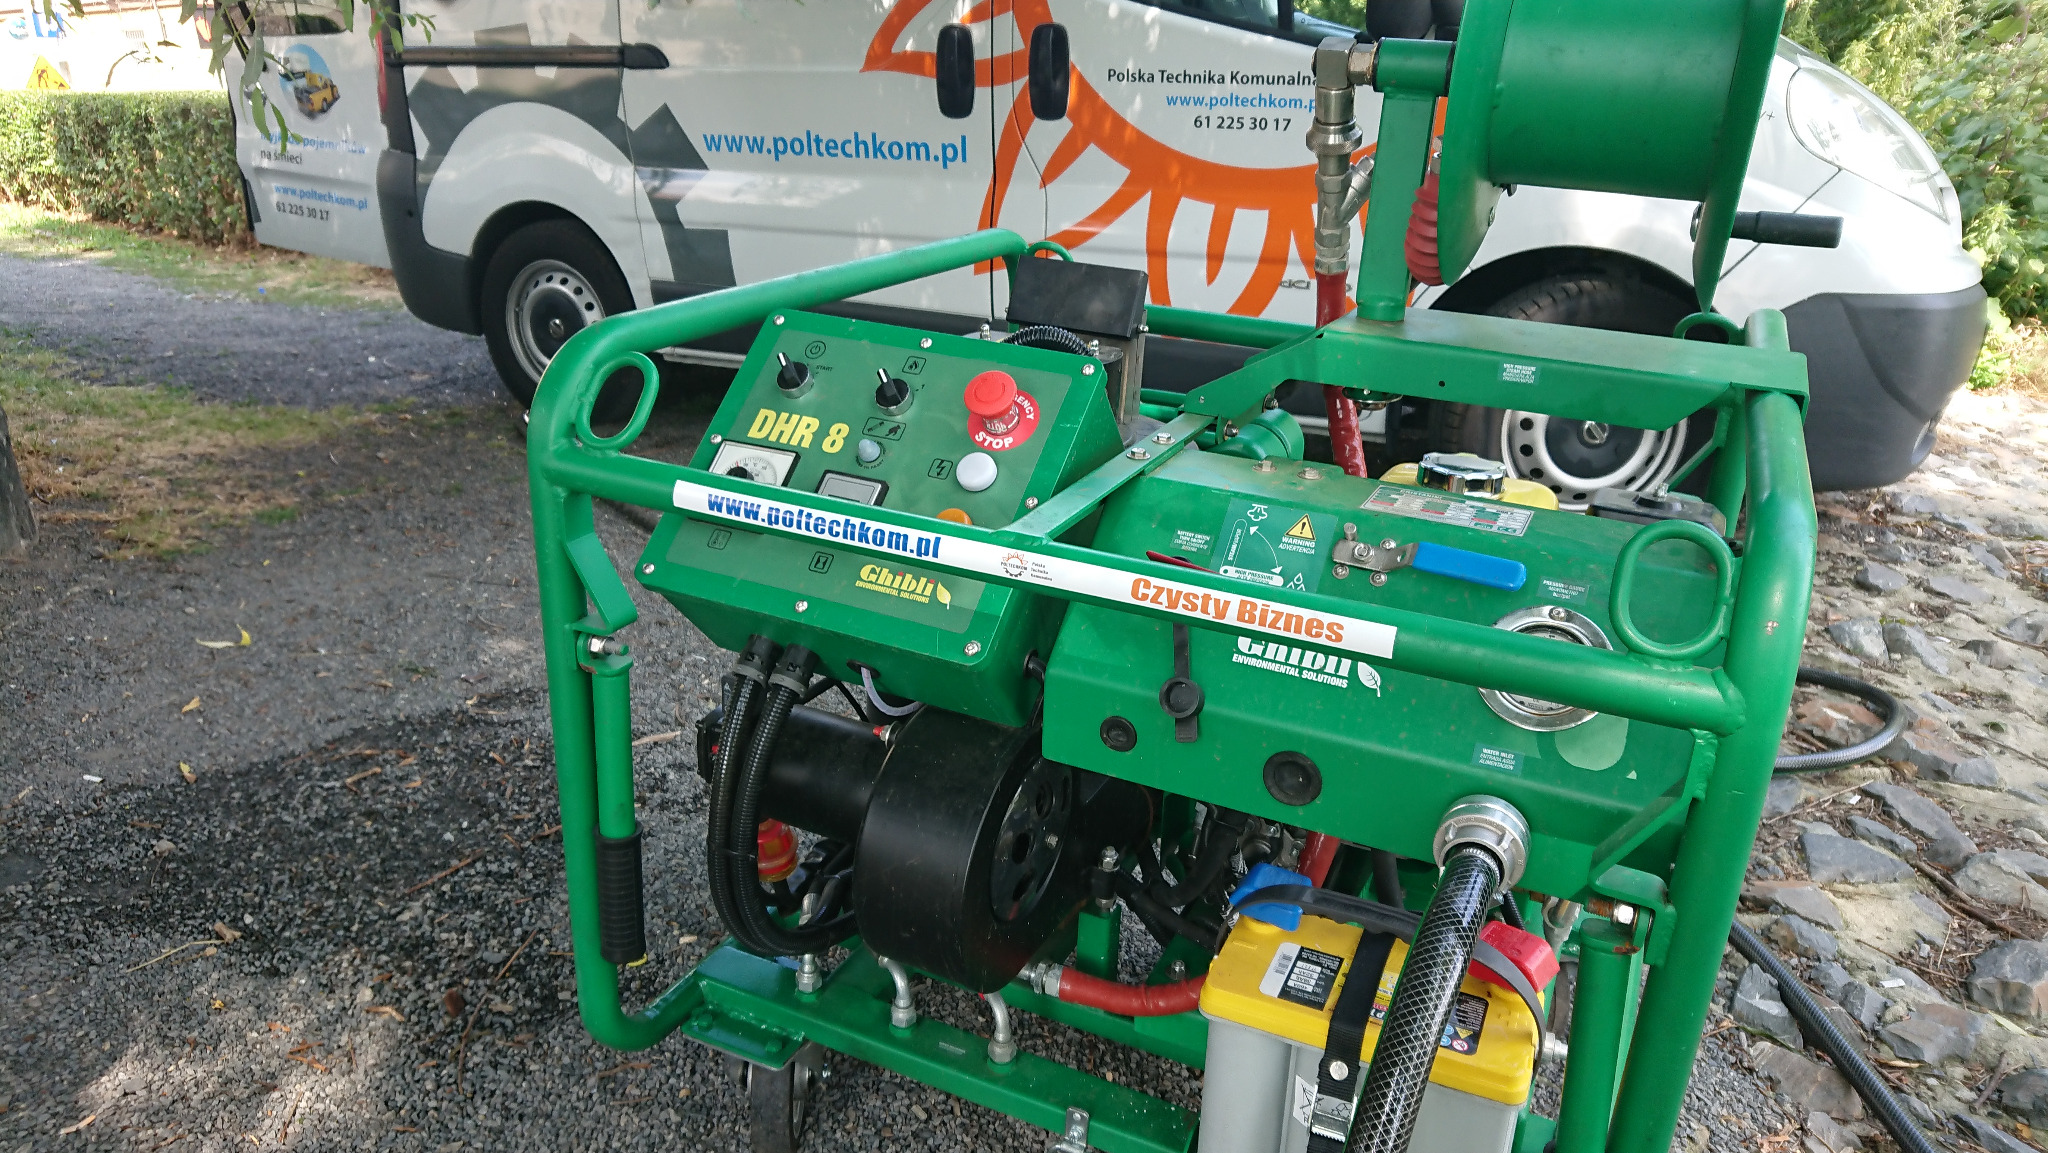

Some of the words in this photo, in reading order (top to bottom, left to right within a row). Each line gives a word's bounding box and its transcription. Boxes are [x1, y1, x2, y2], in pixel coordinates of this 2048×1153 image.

[1107, 68, 1155, 83] Polska
[1158, 69, 1226, 84] Technika
[1166, 93, 1317, 112] www.poltechkom.p
[1193, 116, 1211, 129] 61
[1216, 117, 1245, 129] 225
[1249, 117, 1268, 131] 30
[1273, 118, 1292, 131] 17
[702, 129, 968, 170] www.poltechkom.pl
[274, 184, 368, 210] www.poltechkom.pl
[275, 201, 287, 213] 61
[288, 203, 305, 217] 225
[306, 207, 318, 219] 30
[319, 209, 330, 222] 17
[746, 407, 820, 449] DHR
[821, 422, 851, 454] 8
[974, 431, 1014, 449] STOP
[707, 493, 942, 559] www.poltechkom.pl
[1278, 543, 1315, 555] ADVERTENCIA
[1282, 536, 1316, 548] WARNING
[855, 580, 899, 596] ENVIRONMENTAL
[899, 590, 930, 604] SOLUTIONS
[859, 564, 936, 597] Ghibli
[1130, 578, 1231, 621] Czysty
[1236, 598, 1345, 643] Biznes
[1231, 653, 1300, 677] ENVIRONMENTAL
[1301, 669, 1349, 689] SOLUTIONS
